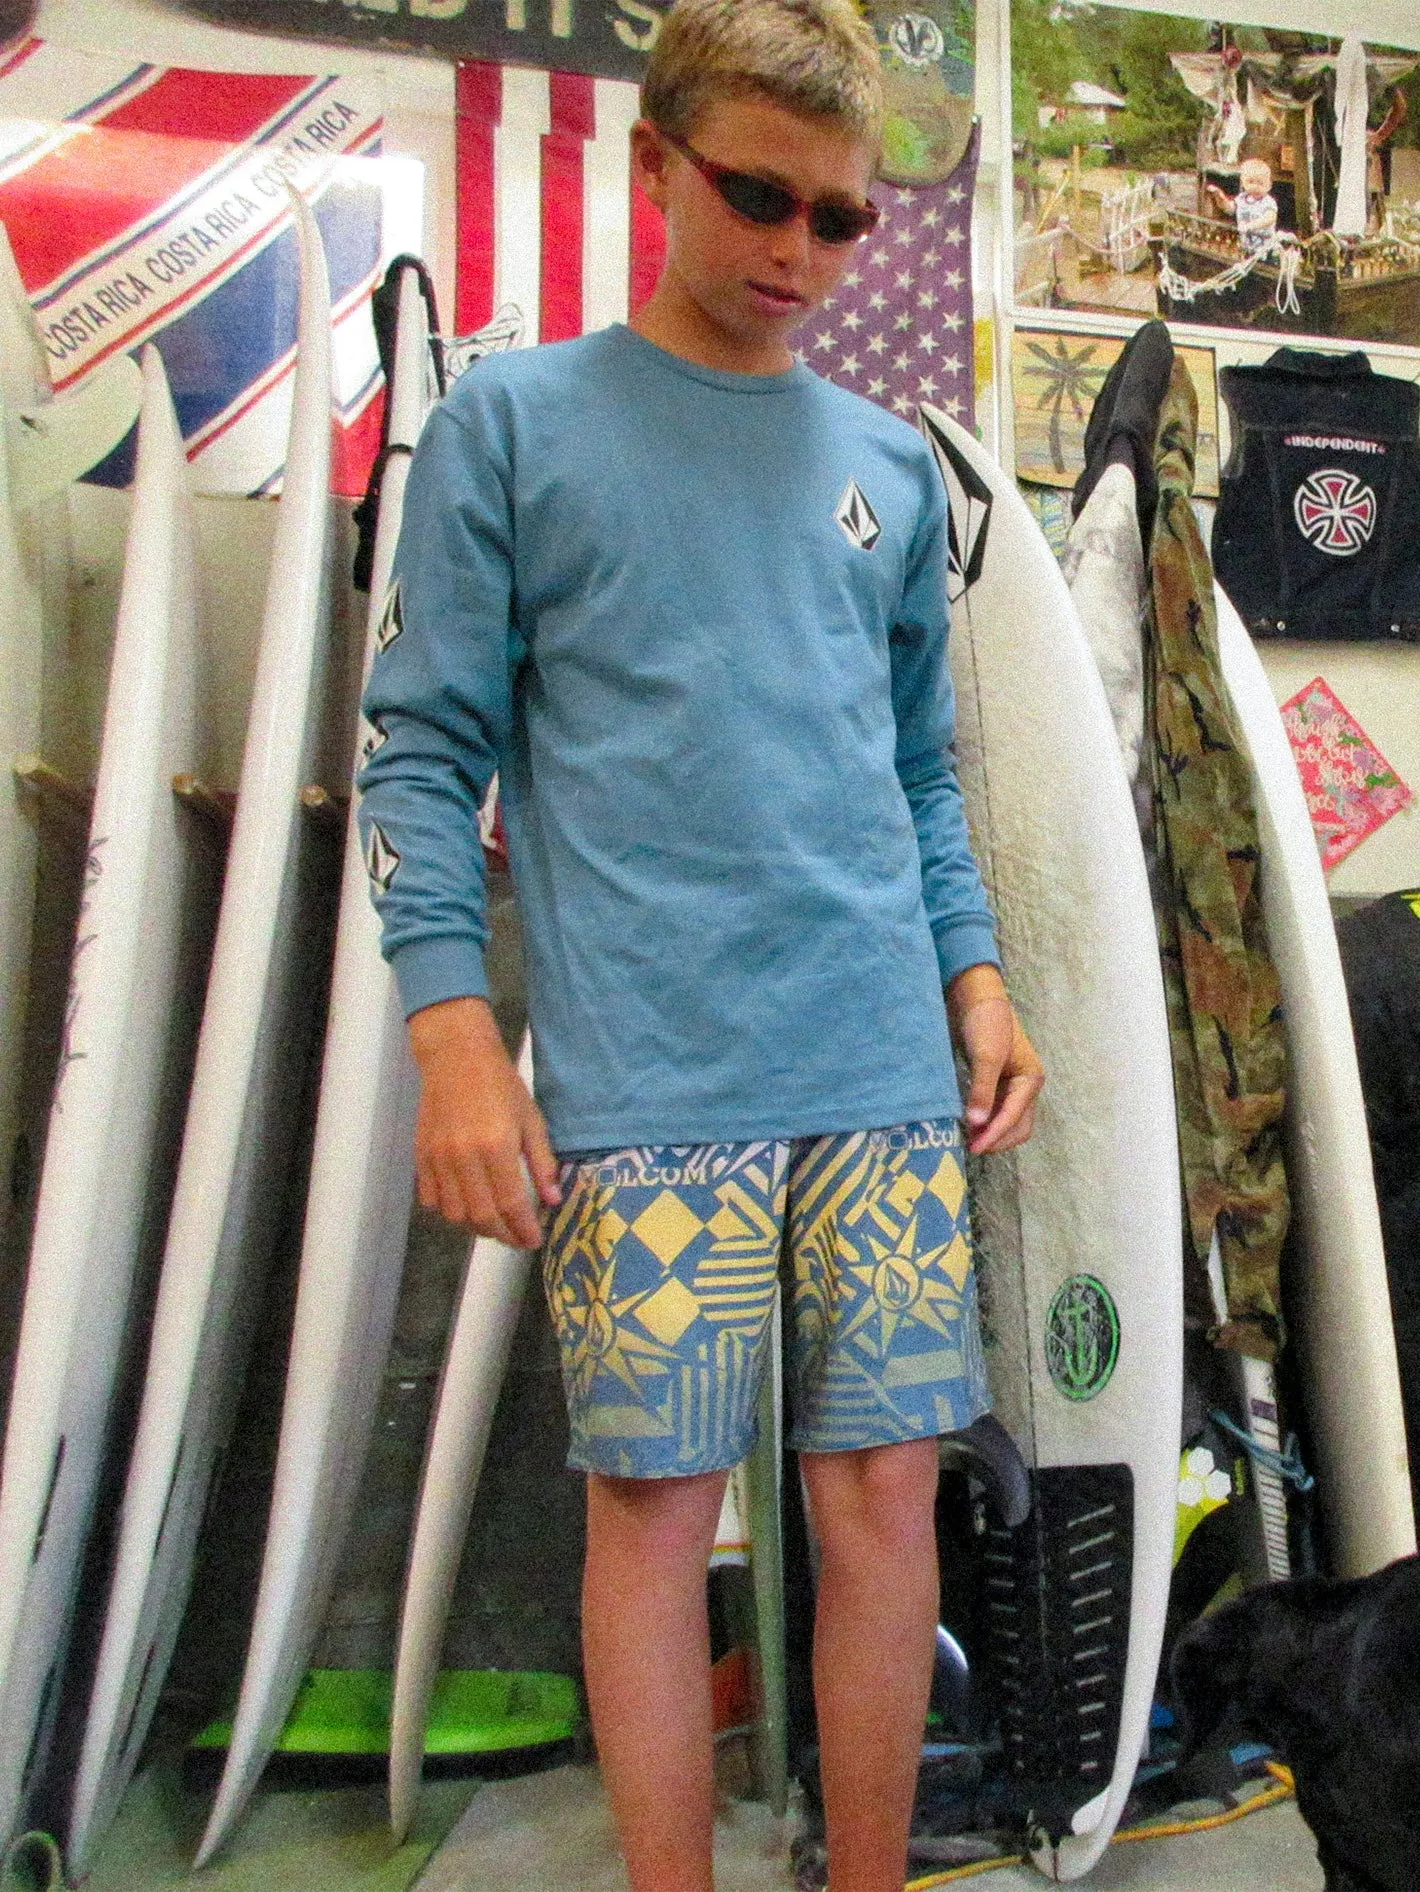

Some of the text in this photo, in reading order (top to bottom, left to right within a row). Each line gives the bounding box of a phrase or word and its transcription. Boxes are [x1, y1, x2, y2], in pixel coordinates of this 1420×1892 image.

[95, 271, 155, 319] RICA
[145, 226, 219, 284] COSTA
[204, 193, 261, 240] RICA
[252, 137, 316, 198] COSTA
[306, 101, 358, 149] RICA
[1292, 436, 1377, 454] INDEPENDENT
